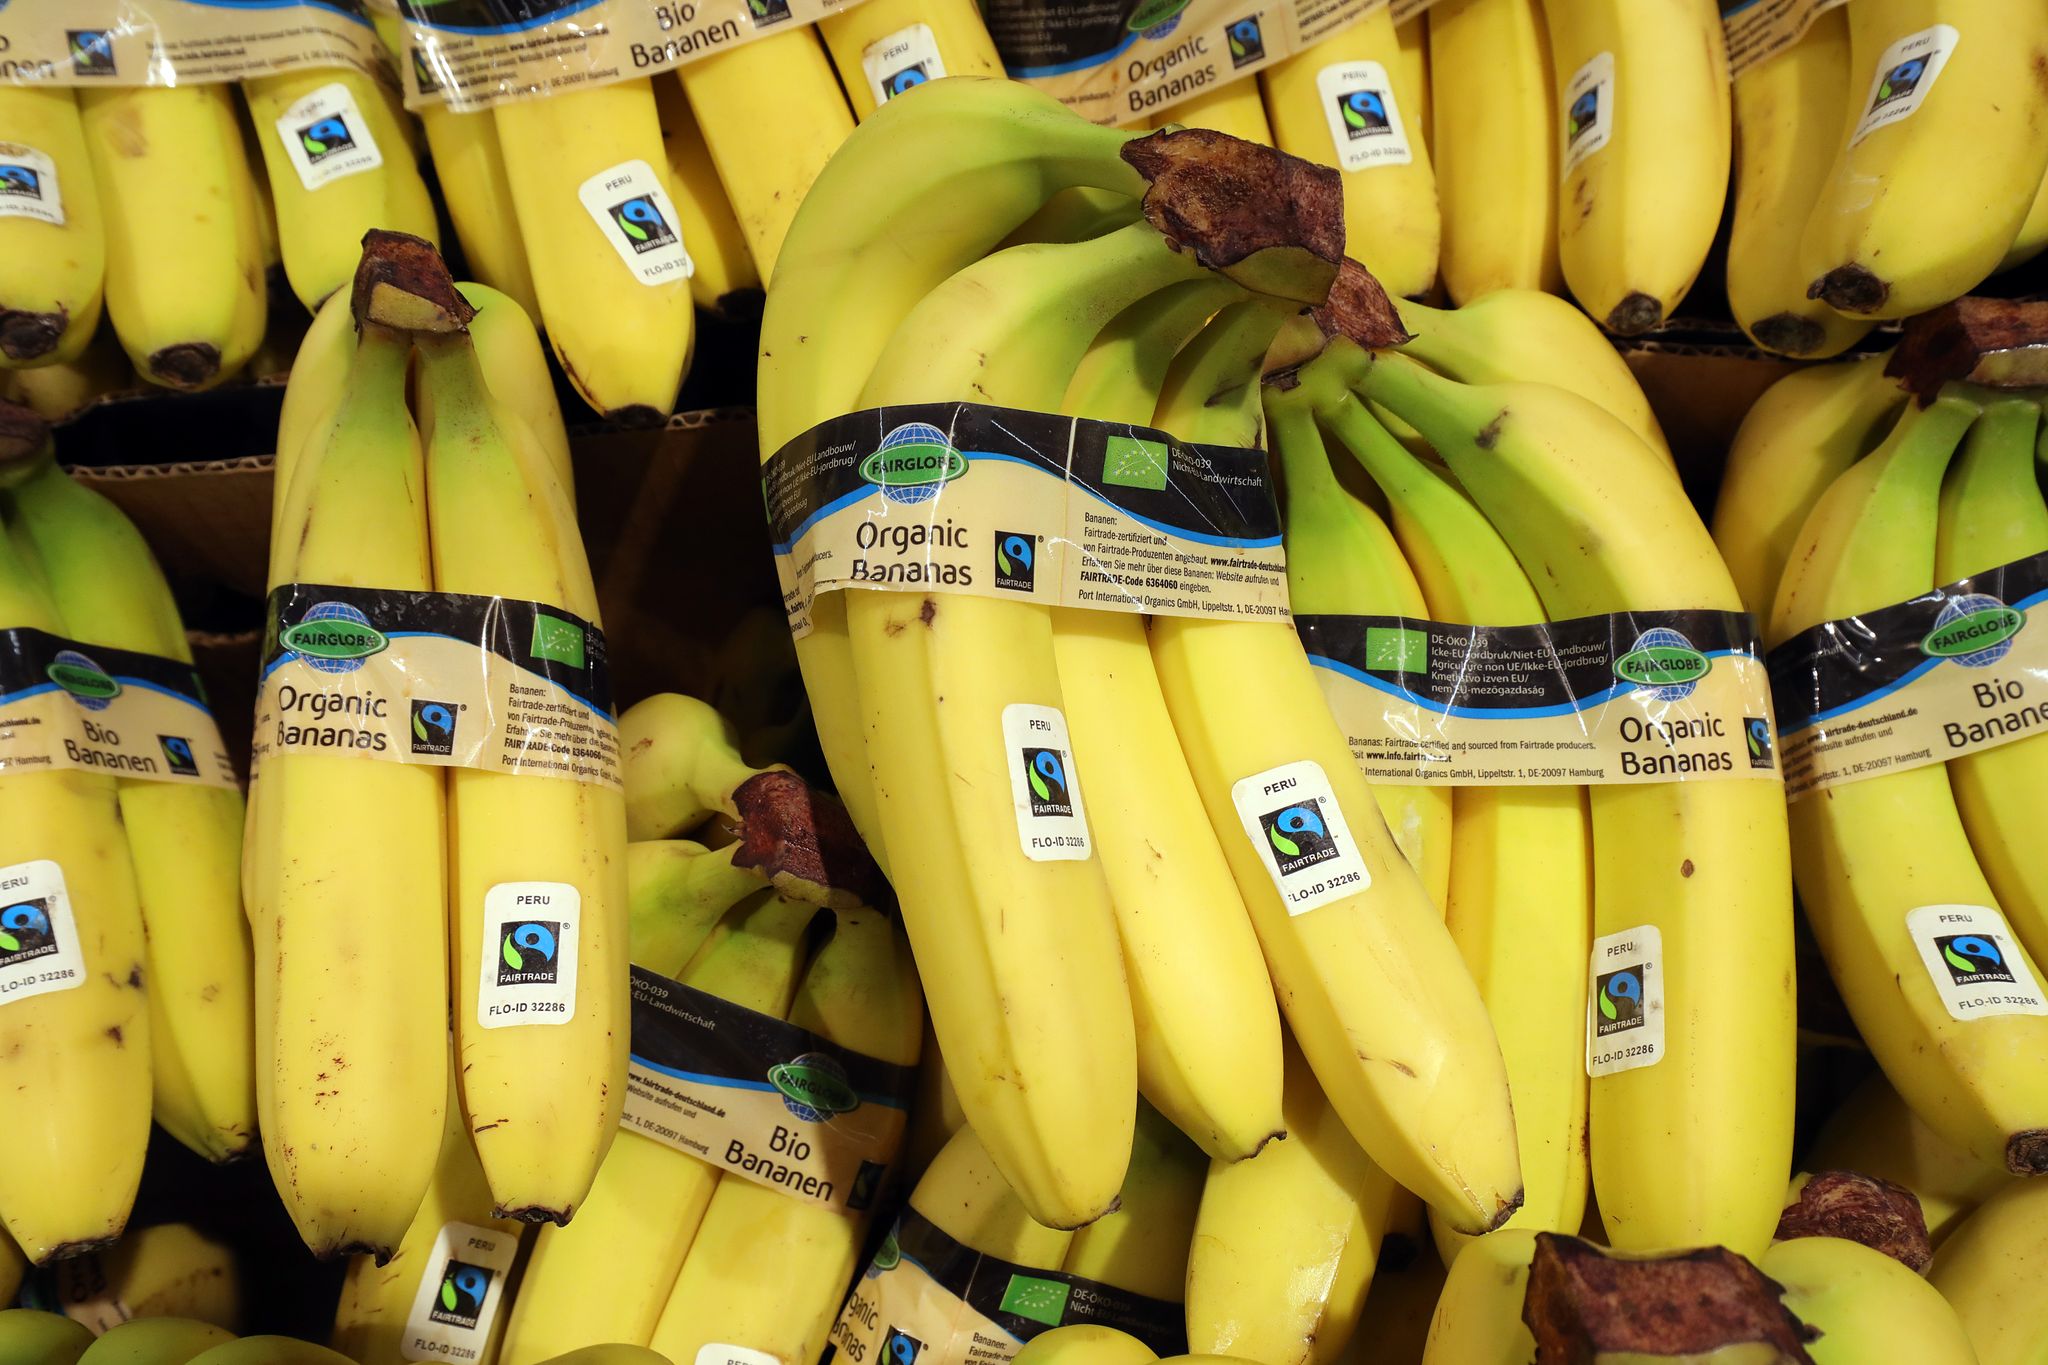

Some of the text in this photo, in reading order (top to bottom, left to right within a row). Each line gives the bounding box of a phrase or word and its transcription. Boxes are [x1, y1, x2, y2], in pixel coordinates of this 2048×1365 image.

[656, 1, 695, 31] Bio
[630, 19, 740, 68] Bananen
[882, 42, 909, 61] PERU
[1128, 35, 1208, 83] Organic
[1129, 64, 1216, 112] Bananas
[605, 175, 633, 191] PERU
[644, 261, 674, 276] FLO-ID
[872, 456, 958, 475] FAIRGLOBE
[1085, 512, 1118, 525] Bananen:
[856, 518, 969, 556] Organic
[1084, 527, 1168, 546] Fairtrade-zertifiziert und
[1083, 544, 1095, 552] von
[1097, 543, 1173, 561] Fairtrade-Produzenten
[851, 559, 973, 586] Bananas
[1082, 556, 1112, 568] Erfahren
[1114, 560, 1125, 570] Sie
[1127, 562, 1145, 571] mehr
[1147, 563, 1163, 573] über
[1164, 565, 1181, 576] diese
[1184, 567, 1214, 579] Bananen:
[1216, 571, 1243, 583] Website
[996, 577, 1032, 590] FAIRTRADE
[1080, 571, 1211, 593] FAIRTRADE-Code 6364060 eingeben.
[1078, 589, 1094, 600] Port
[1095, 591, 1142, 605] International
[1144, 596, 1175, 608] Organics
[1177, 599, 1200, 610] GmbH,
[1202, 601, 1235, 612] Lippeltstr.
[1237, 604, 1244, 614] 1,
[1245, 606, 1277, 616] DE-20097
[1933, 613, 2016, 650] FAIRGLOBE
[1553, 641, 1606, 657] andbouw/
[1626, 658, 1701, 674] FAIRGLOBE
[1482, 673, 1509, 683] izven
[1511, 673, 1530, 684] EU/
[510, 683, 546, 697] Bananen:
[1431, 685, 1453, 693] nem
[1972, 678, 2024, 709] Bio
[278, 685, 387, 720] Organic
[508, 697, 590, 720] Fairtrade-zertifiziert und
[507, 712, 520, 721] von
[1030, 720, 1051, 731] PERU
[82, 720, 120, 746] Bio
[276, 721, 387, 751] Bananas
[1619, 712, 1725, 748] Organic
[1877, 727, 1894, 739] und
[413, 743, 450, 753] FAIRTRADE
[504, 738, 570, 754] FAIRTRADE-Code
[1348, 736, 1597, 751] Bananas: Fairtrade certified and sourced from Fairtrade producers.
[64, 739, 158, 773] Bananen
[1621, 751, 1734, 776] Bananas
[1895, 748, 1933, 764] Hamburg
[502, 755, 518, 766] Port
[571, 763, 598, 777] Organics
[1365, 767, 1605, 779] International Organics GmbH, Lippeltstr. 1, DE-20097 Hamburg
[1264, 777, 1297, 796] PERU
[1034, 804, 1072, 814] FAIRTRADE
[1032, 837, 1084, 848] FLO-ID 32286
[1282, 847, 1336, 872] FAIRTRADE
[1327, 871, 1361, 889] 32286
[516, 896, 550, 905] PERU
[1939, 914, 1973, 923] PERU
[1607, 941, 1633, 958] PERU
[39, 969, 75, 982] 32286
[500, 973, 554, 983] FAIRTRADE
[1956, 973, 2013, 984] FAIRTRADE
[489, 1002, 566, 1016] FLO-ID 32286
[1958, 996, 2038, 1010] FLO-ID 32286
[1599, 1016, 1643, 1034] FAIRTRADE
[1592, 1043, 1654, 1066] FLO-ID 32286
[683, 1109, 697, 1119] und
[643, 1120, 679, 1140] DE-20097
[678, 1135, 710, 1155] Hamburg
[769, 1125, 811, 1161] Bio
[724, 1139, 833, 1202] Bananen
[468, 1238, 496, 1251] PERU
[432, 1311, 476, 1328] FAIRTRADE
[415, 1339, 449, 1354] FLO-ID
[973, 1332, 1007, 1350] Bananen:
